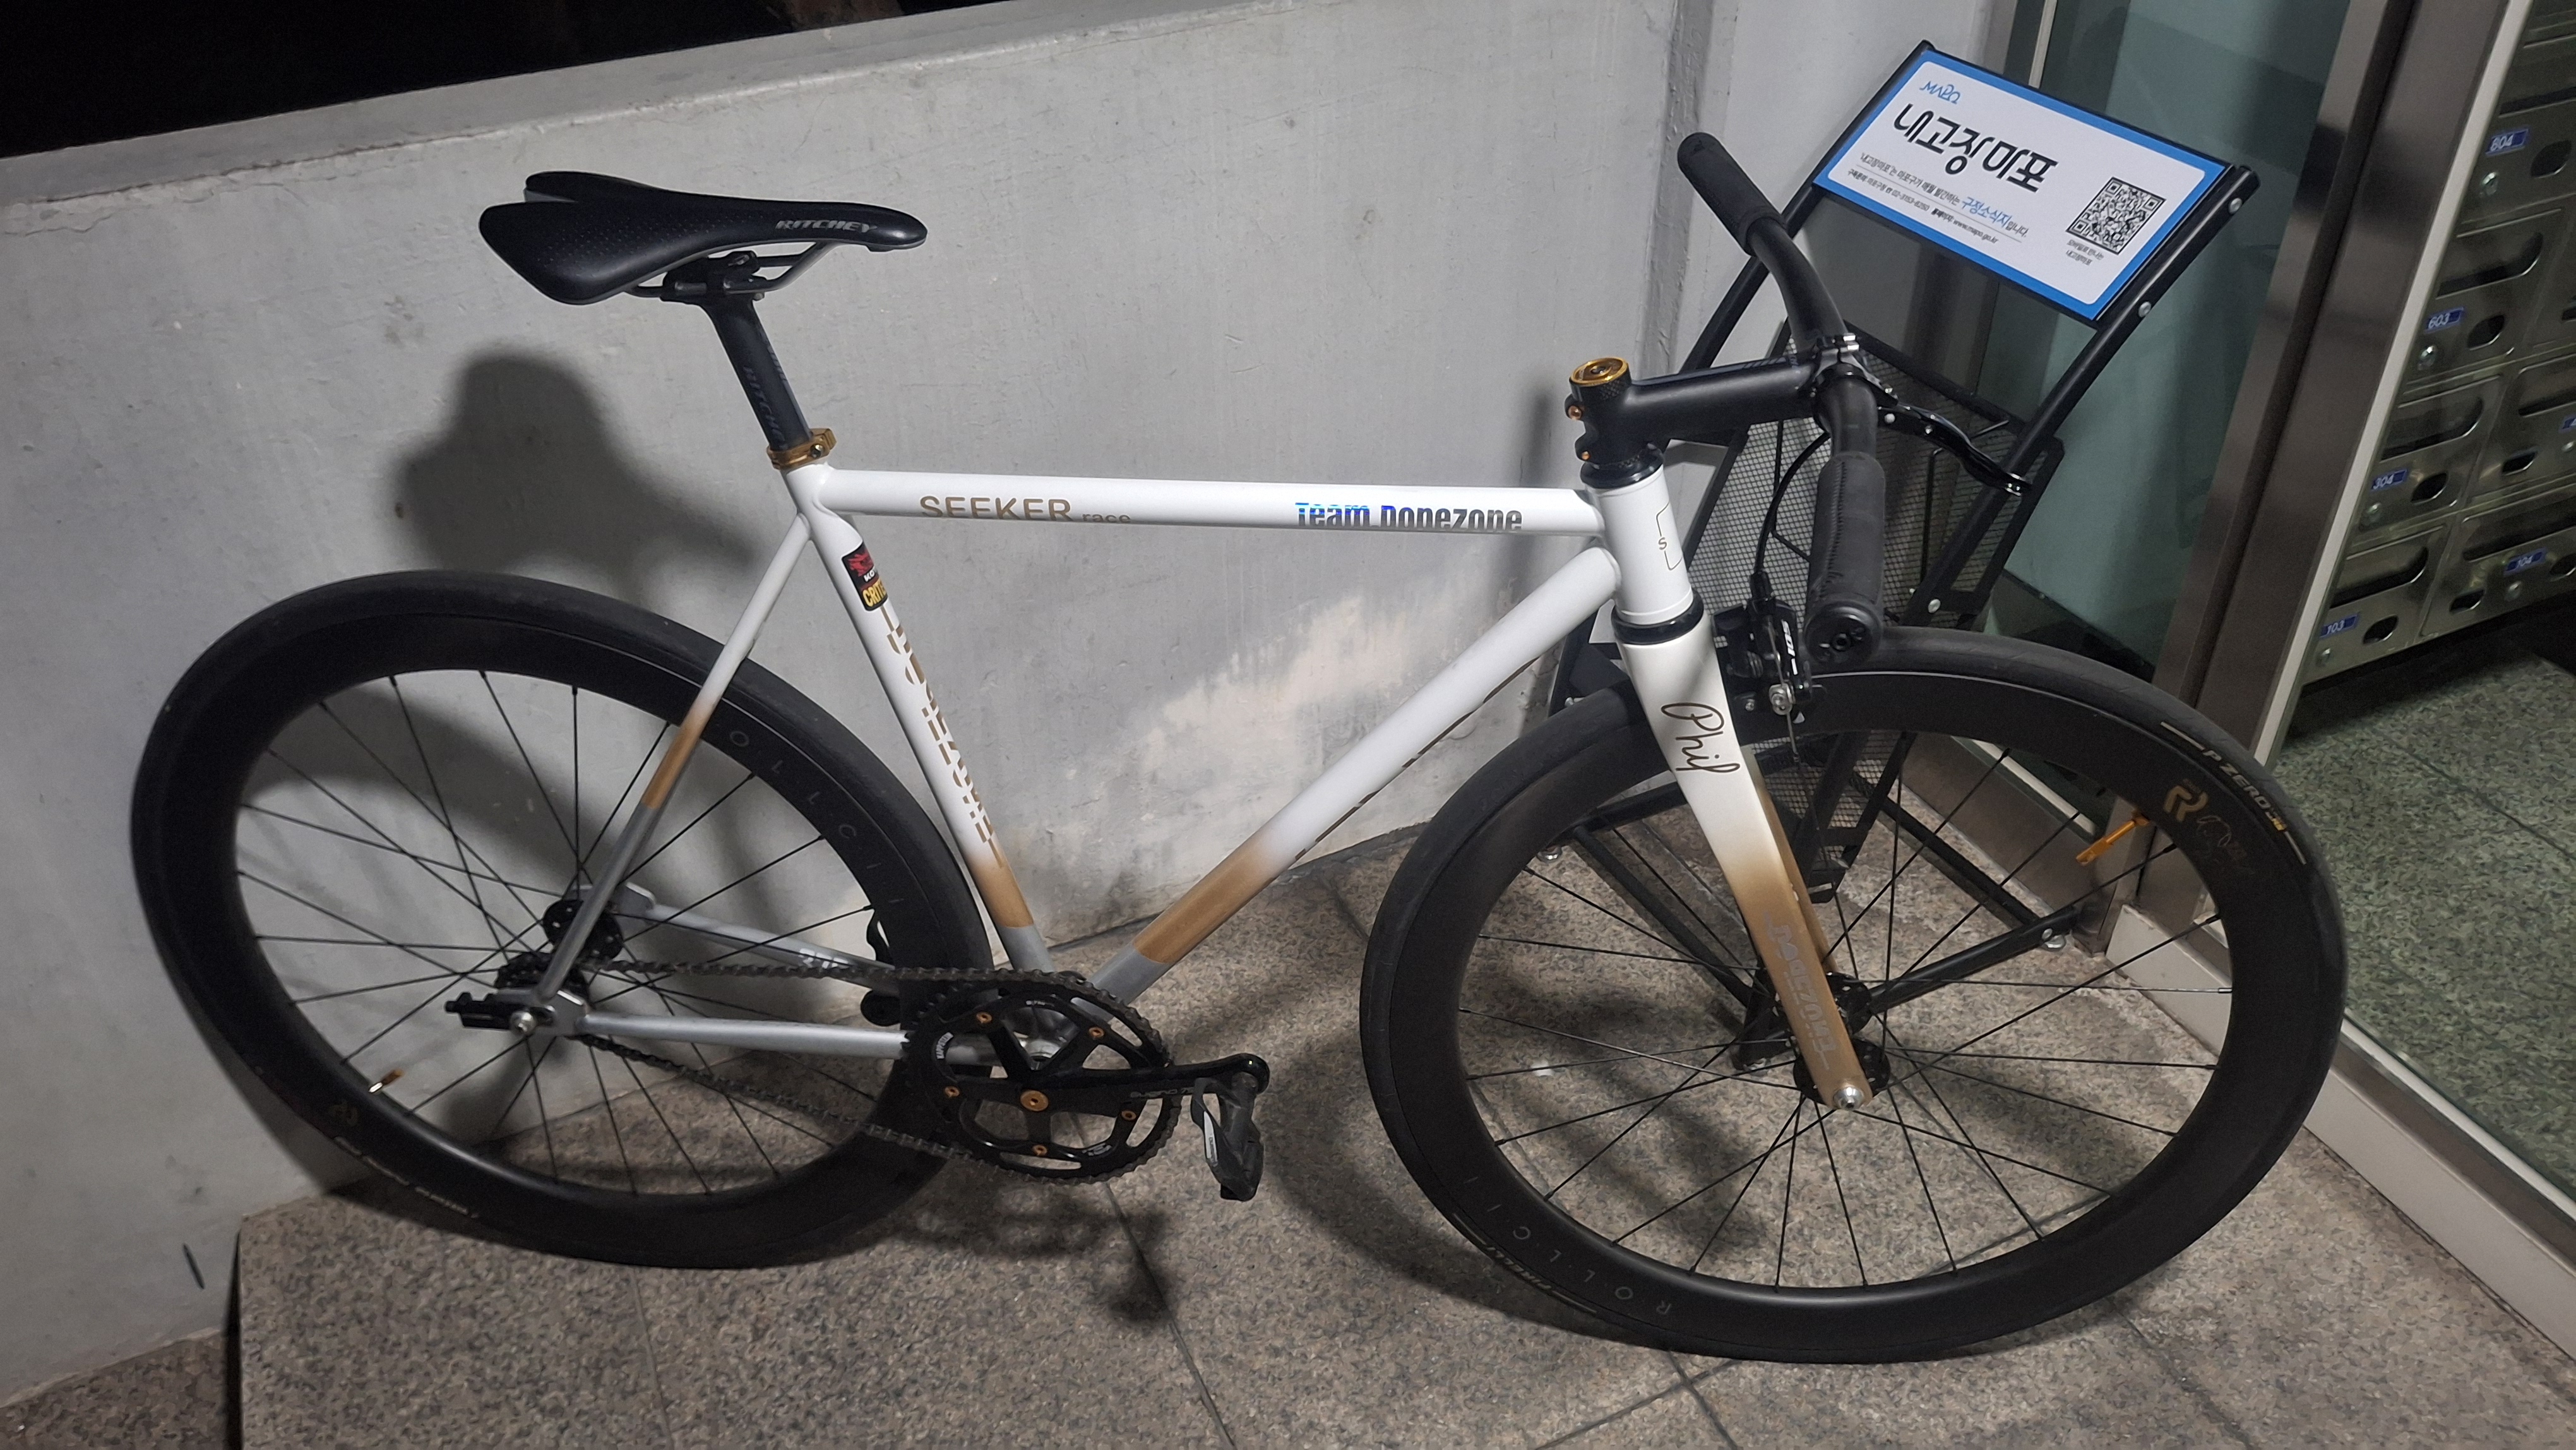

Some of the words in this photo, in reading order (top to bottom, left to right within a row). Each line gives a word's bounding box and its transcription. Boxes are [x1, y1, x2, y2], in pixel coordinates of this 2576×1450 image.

[775, 219, 878, 234] RITCHEY
[920, 495, 1073, 521] SEEKER
[2219, 762, 2272, 810] ZERO
